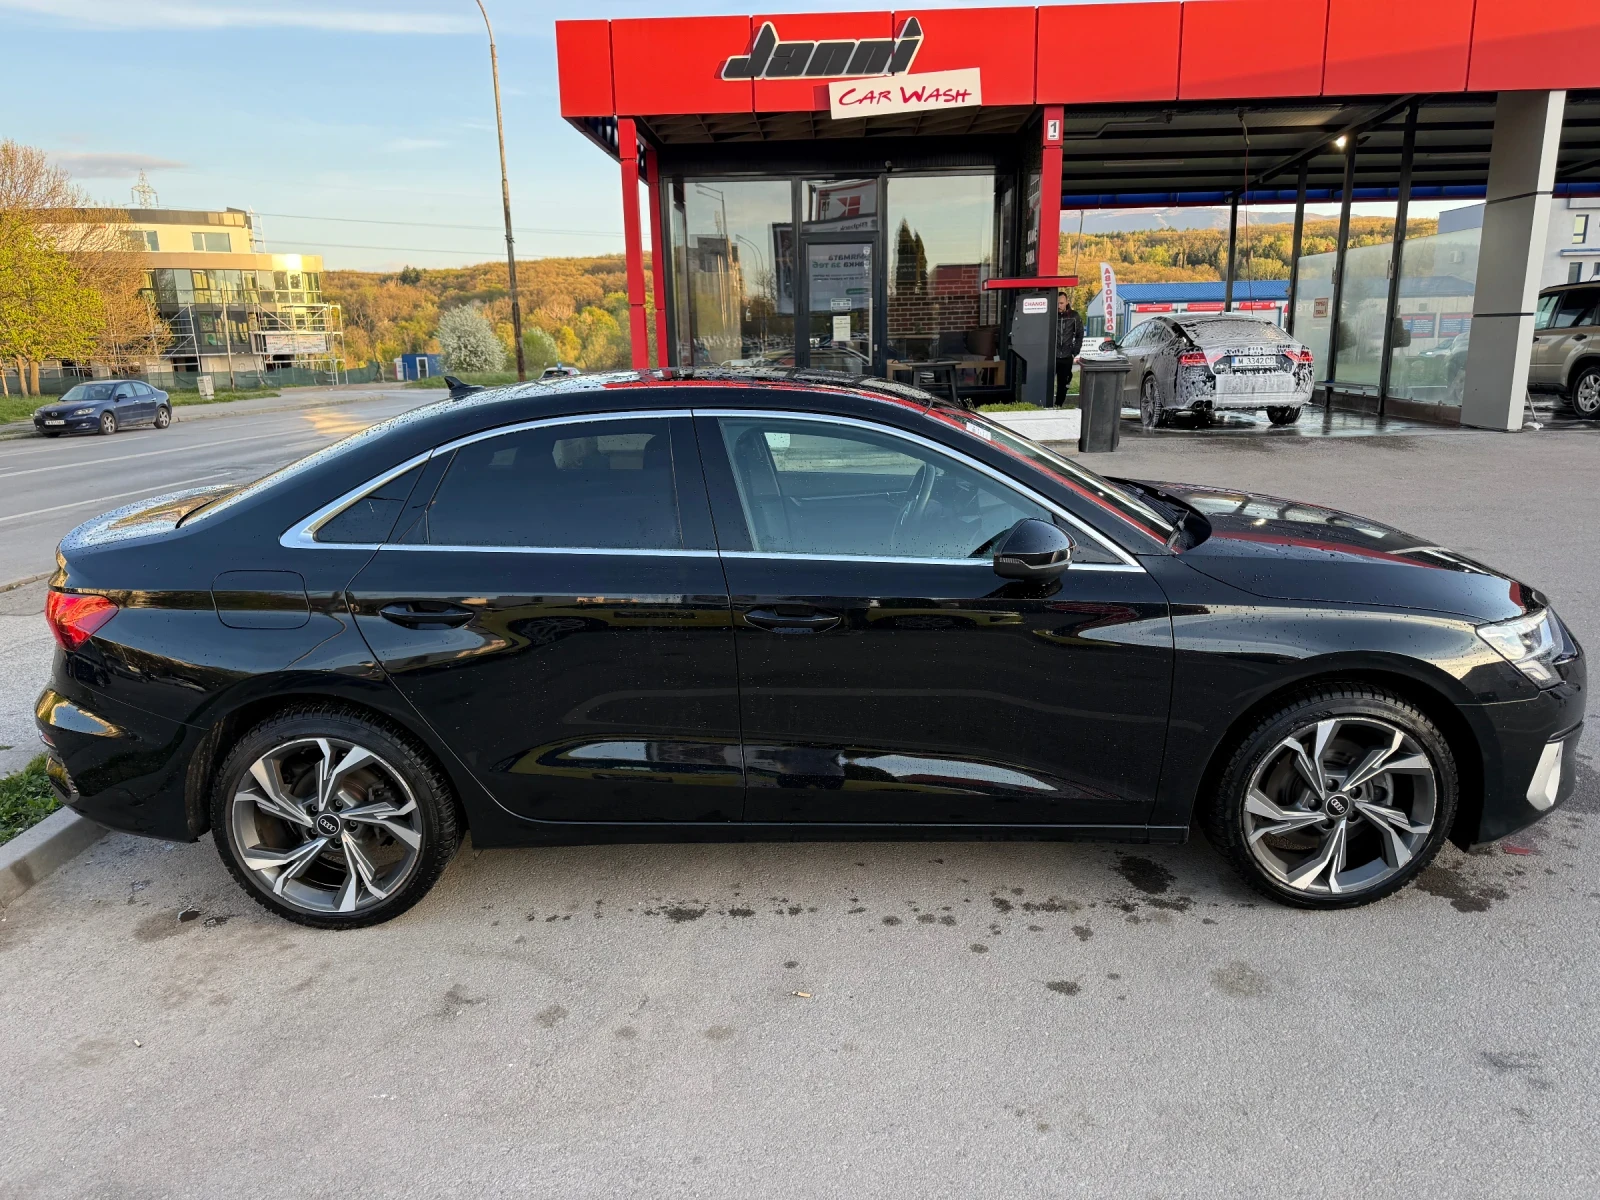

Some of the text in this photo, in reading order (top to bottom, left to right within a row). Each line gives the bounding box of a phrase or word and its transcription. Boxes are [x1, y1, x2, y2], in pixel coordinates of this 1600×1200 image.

[838, 85, 973, 106] CAR WASH
[1050, 121, 1057, 134] 1
